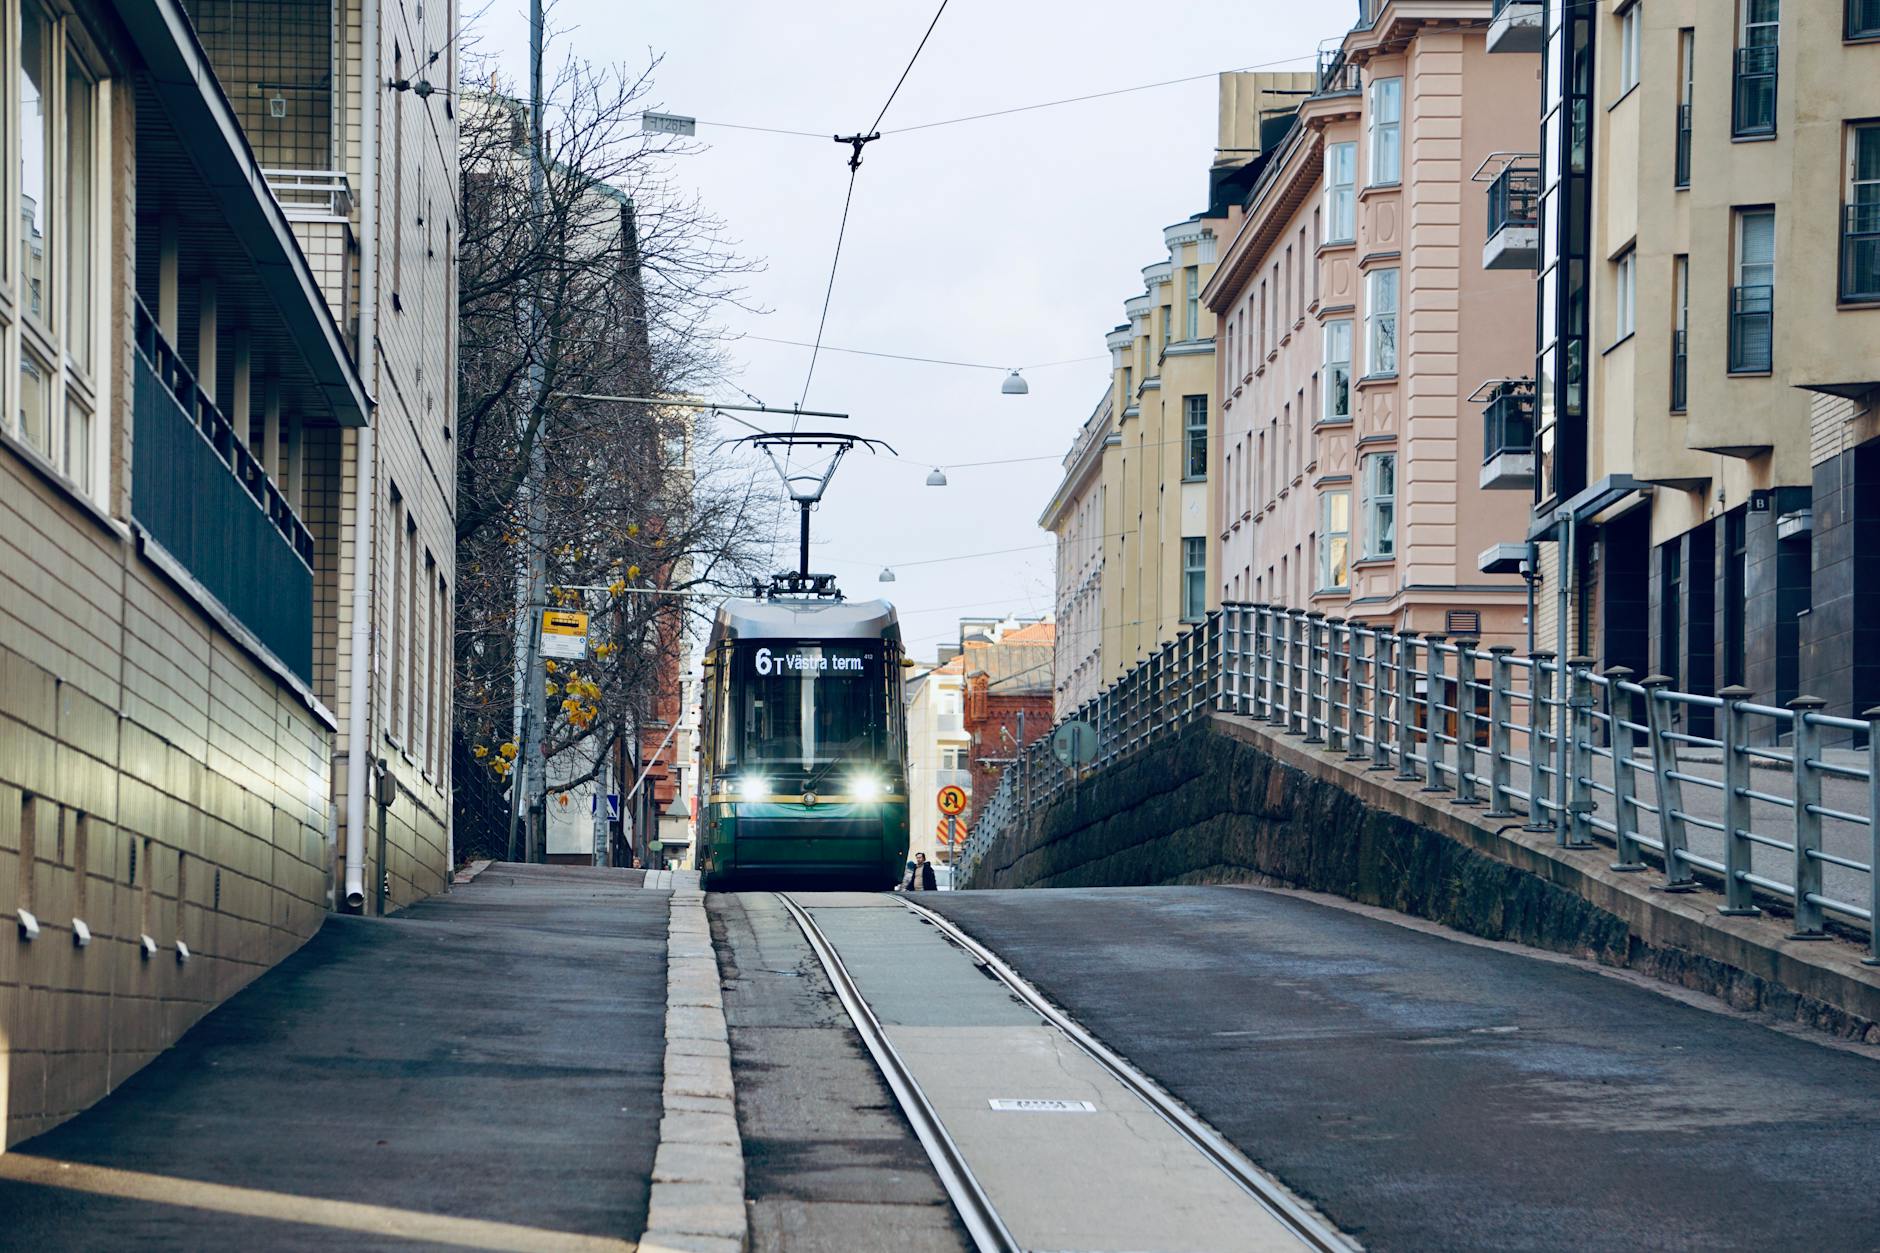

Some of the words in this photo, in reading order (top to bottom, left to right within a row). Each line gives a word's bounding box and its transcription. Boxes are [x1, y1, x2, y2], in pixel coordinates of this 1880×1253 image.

[1756, 498, 1765, 509] B
[785, 654, 827, 670] Västra
[832, 654, 864, 670] term.
